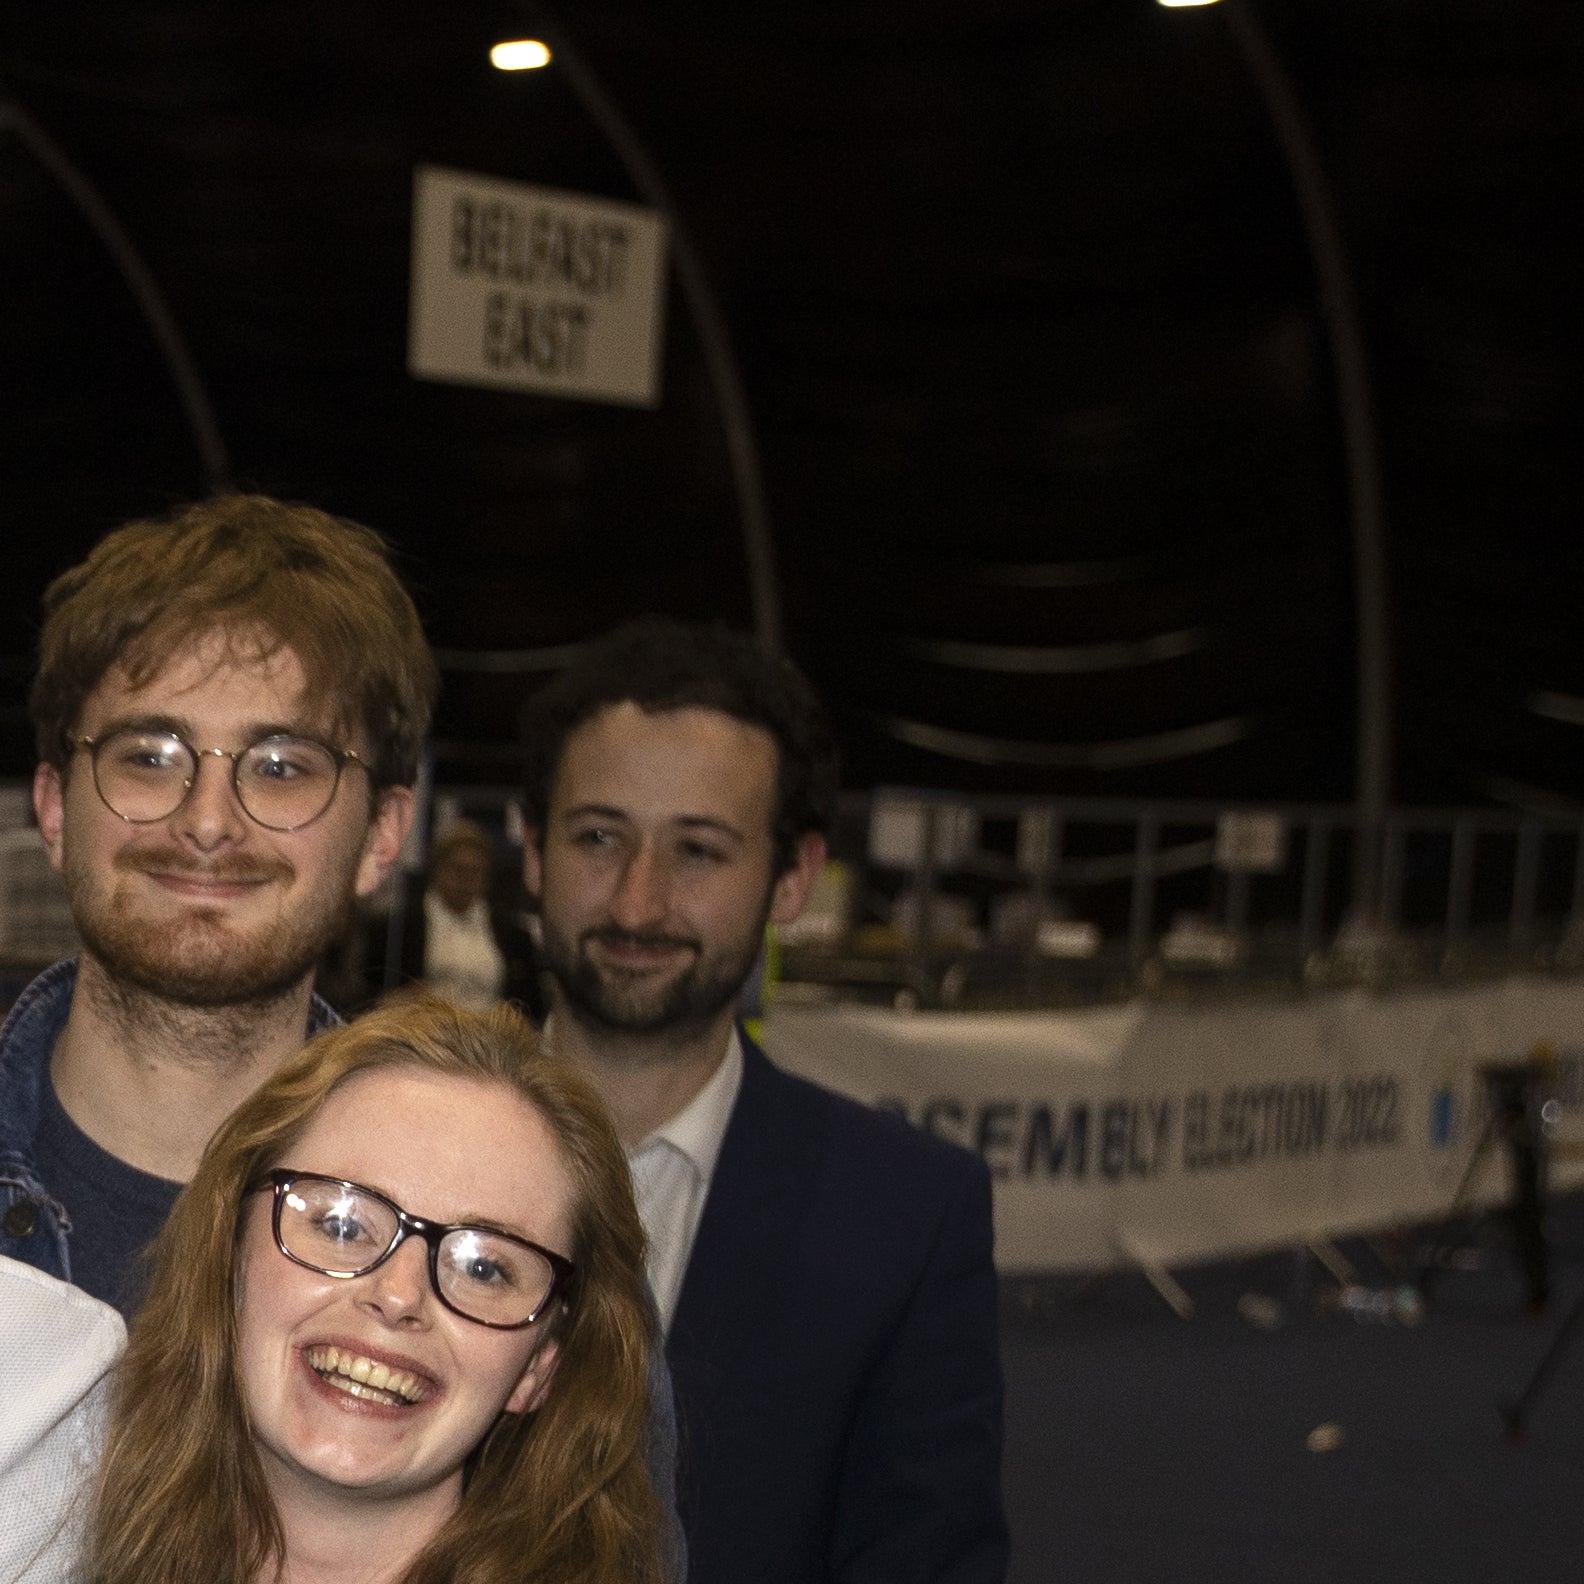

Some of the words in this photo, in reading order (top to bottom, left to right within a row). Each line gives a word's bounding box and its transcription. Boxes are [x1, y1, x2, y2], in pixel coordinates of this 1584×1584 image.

[450, 198, 628, 293] BELFAST
[484, 291, 589, 372] EAST
[1183, 1081, 1329, 1173] ELECTION
